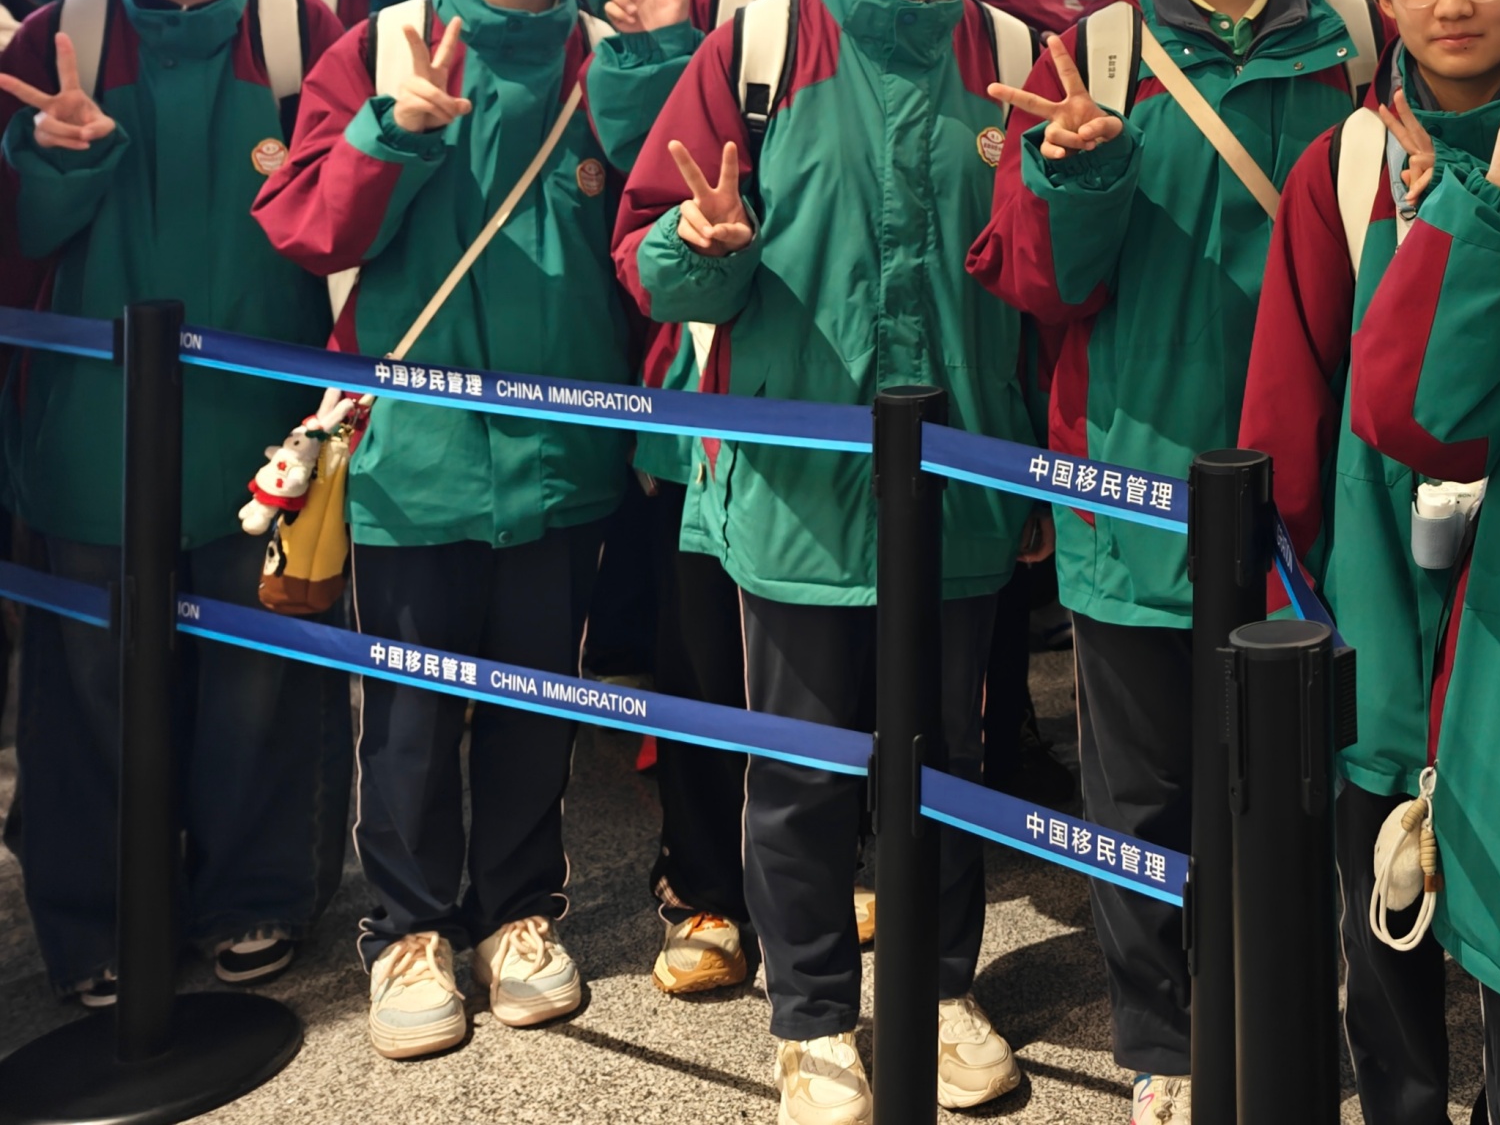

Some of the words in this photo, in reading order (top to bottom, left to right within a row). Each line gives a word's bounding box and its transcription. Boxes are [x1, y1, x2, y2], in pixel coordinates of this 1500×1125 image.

[375, 362, 482, 396] 中国移民管理
[497, 380, 543, 401] CHINA
[548, 386, 652, 414] IMMIGRATION
[1029, 454, 1172, 511] 中国移民管理
[370, 642, 477, 685] 中国移民管理
[491, 670, 537, 695] CHINA
[543, 682, 647, 717] IMMIGRATION
[1026, 811, 1166, 883] 中国移民管理
